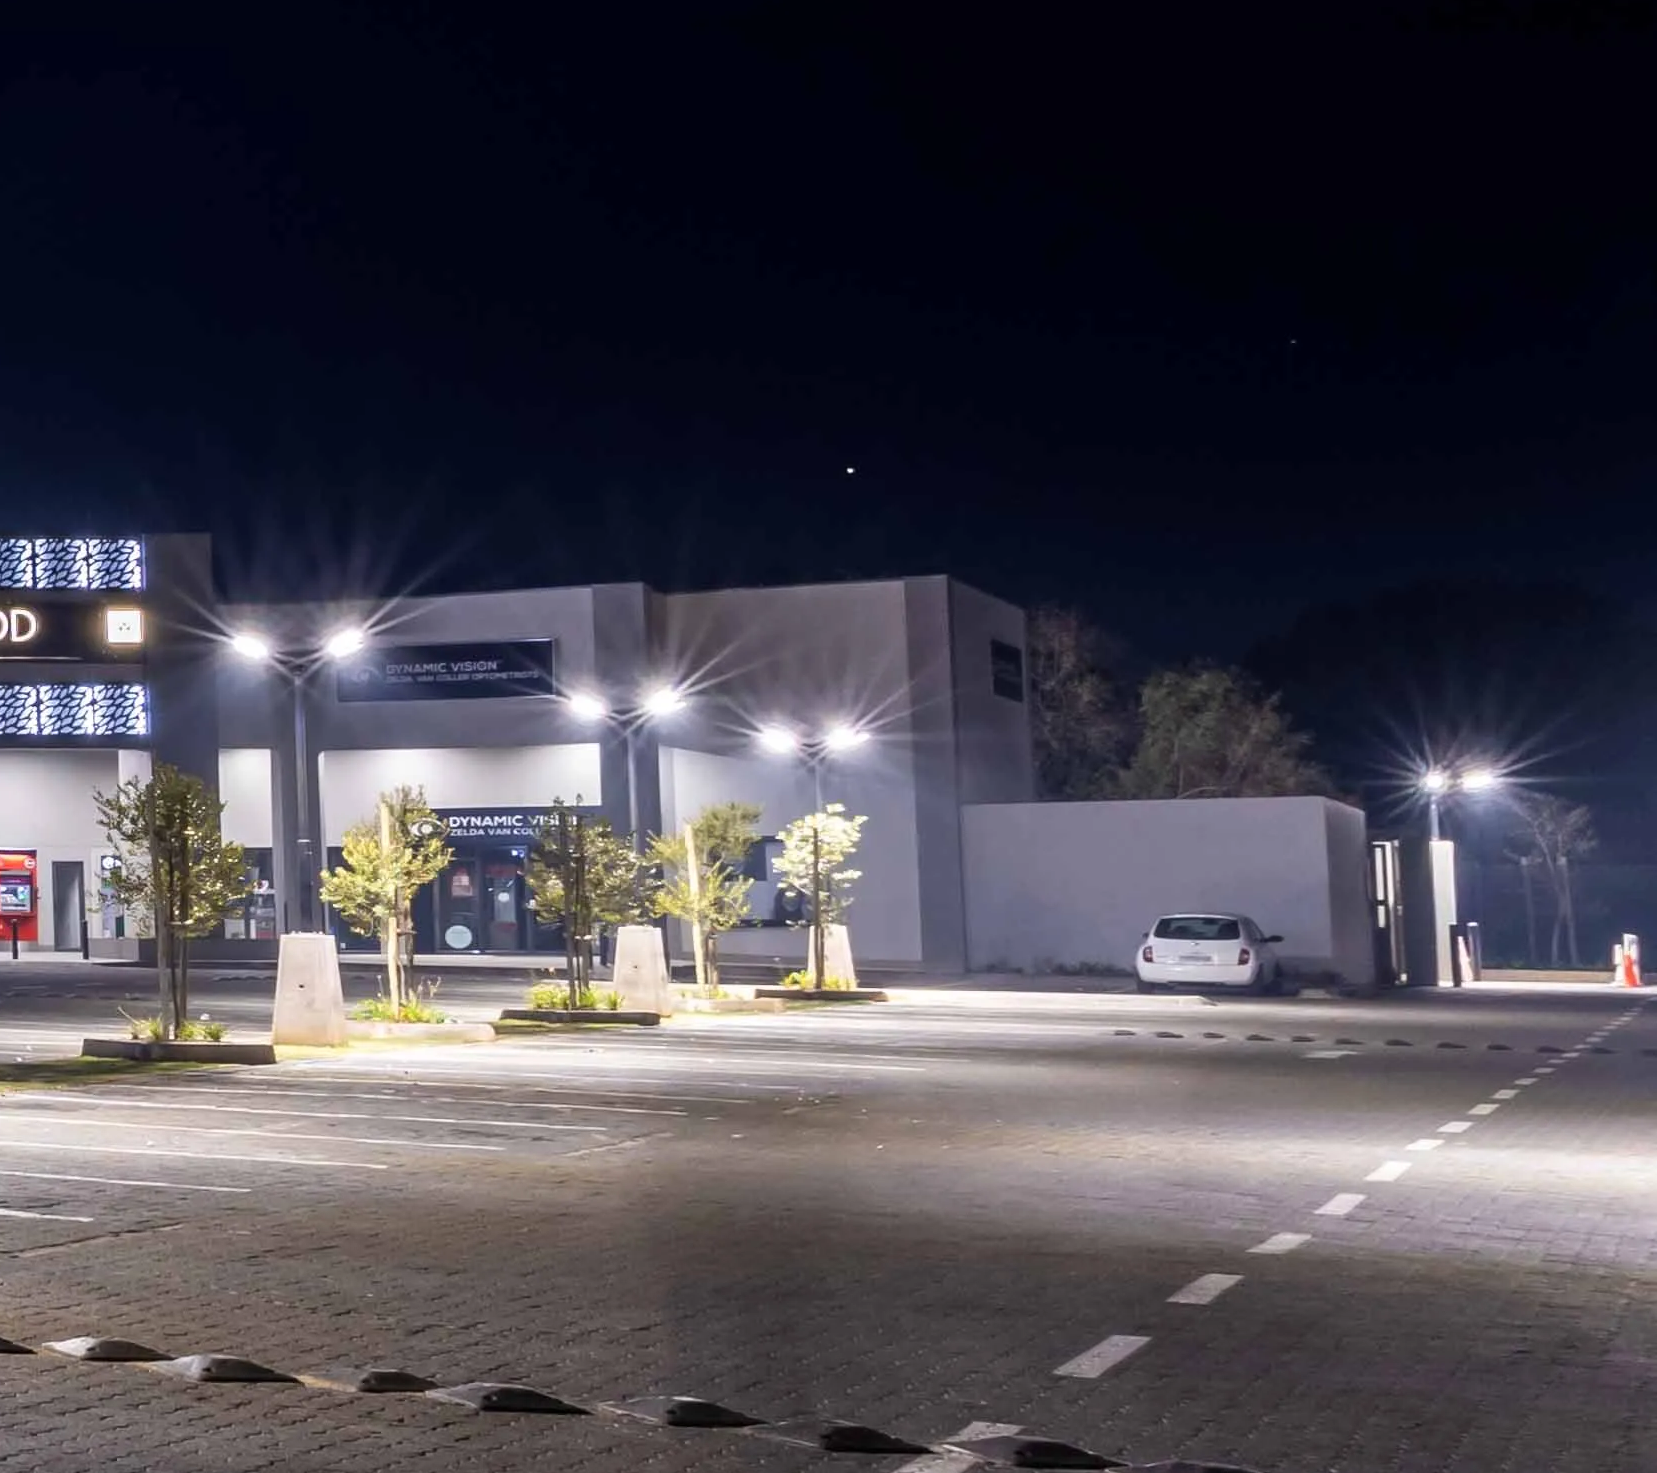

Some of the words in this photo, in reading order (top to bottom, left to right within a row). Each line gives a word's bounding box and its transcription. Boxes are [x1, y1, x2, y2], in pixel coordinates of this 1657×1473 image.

[386, 662, 447, 674] DYNAMIC
[450, 661, 498, 672] VISION
[448, 814, 524, 828] DYNAMIC
[527, 813, 578, 826] VISI
[450, 828, 486, 836] ZELDA
[487, 827, 511, 836] VAN
